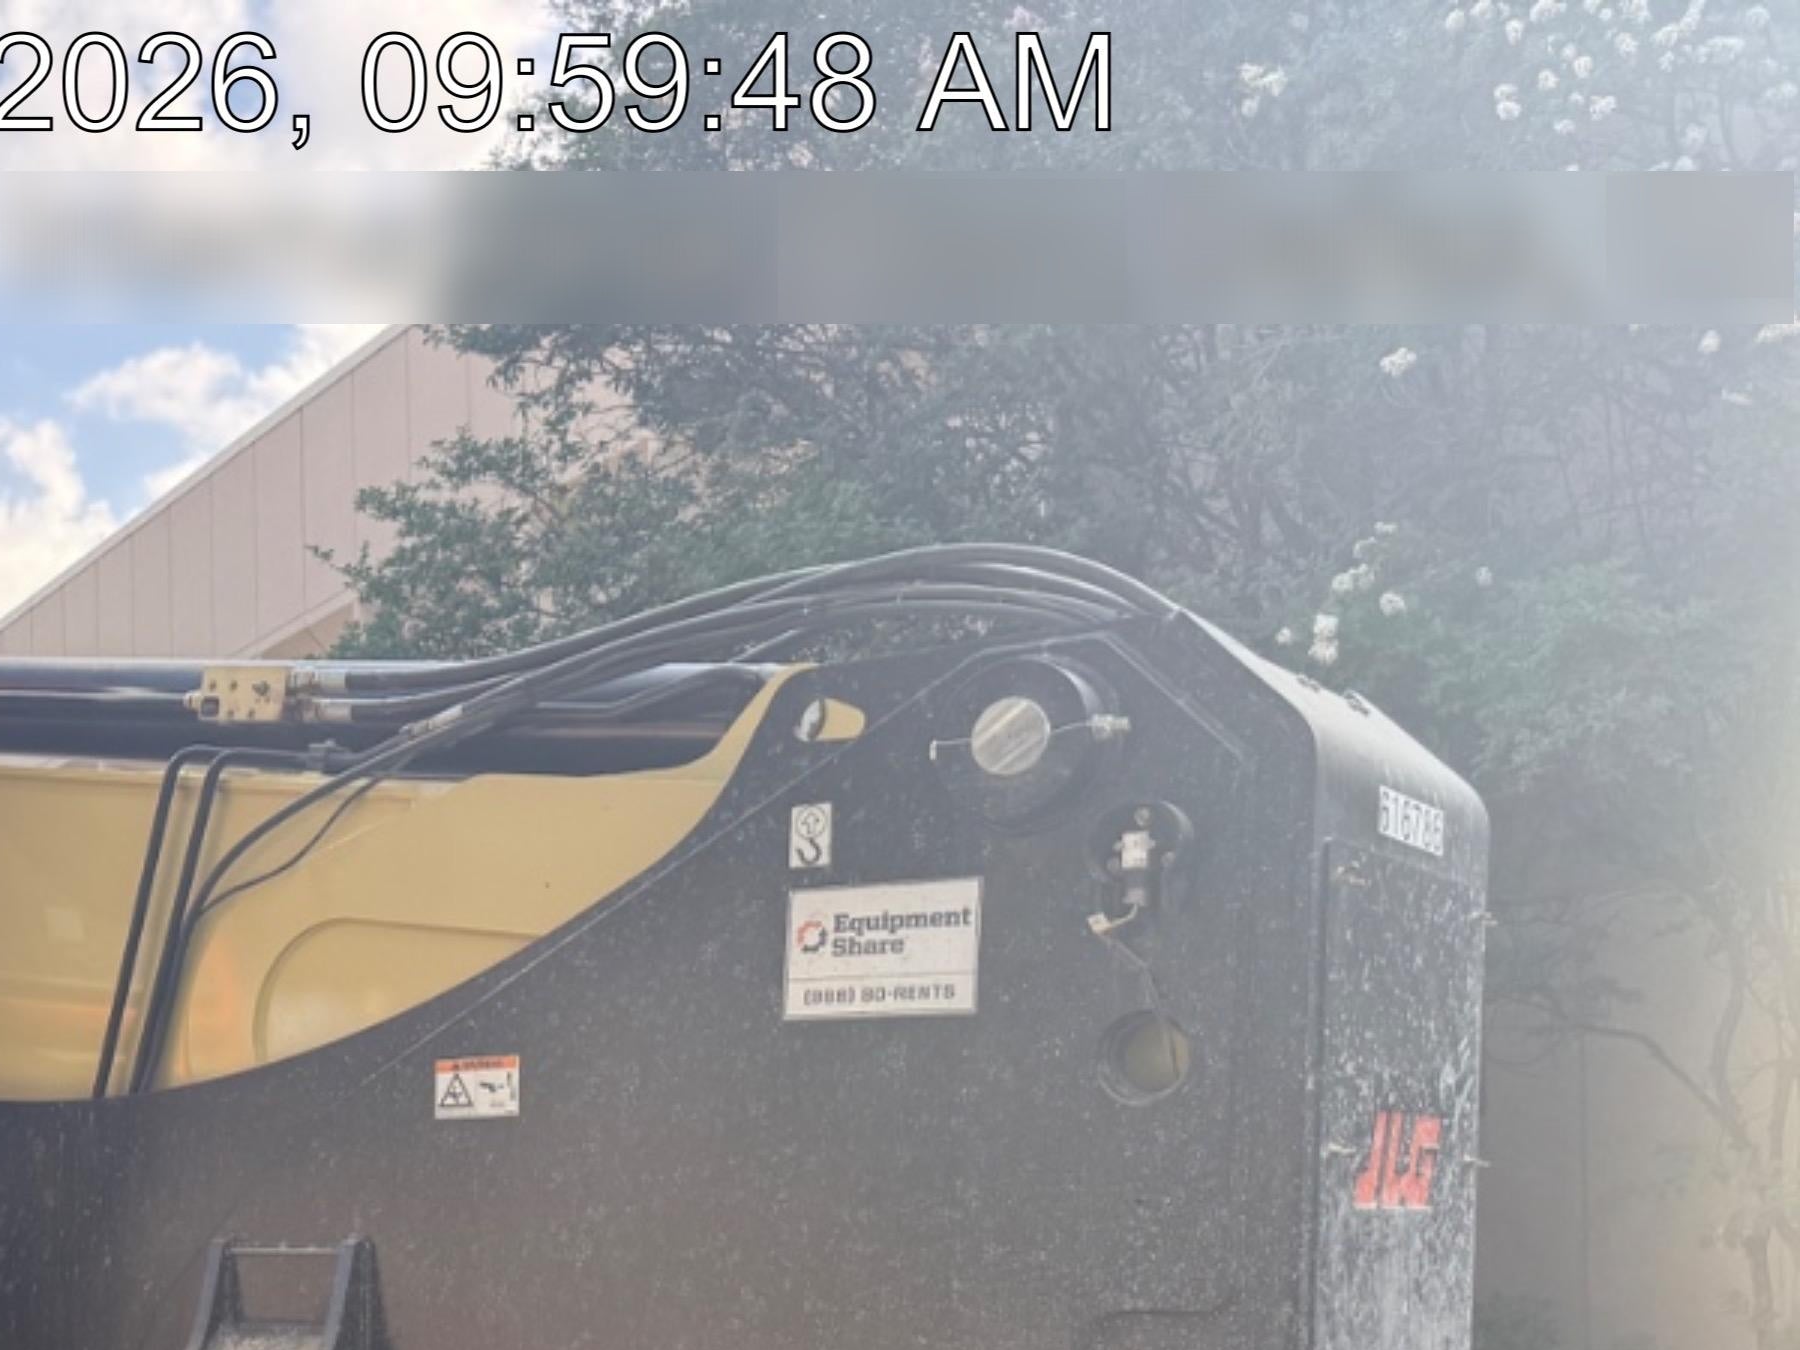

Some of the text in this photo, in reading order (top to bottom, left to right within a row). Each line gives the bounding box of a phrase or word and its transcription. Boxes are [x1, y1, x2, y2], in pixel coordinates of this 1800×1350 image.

[832, 908, 972, 938] Equipment
[831, 936, 905, 957] Share
[860, 983, 956, 1003] 80-RENTS
[1353, 1110, 1441, 1210] JLG
